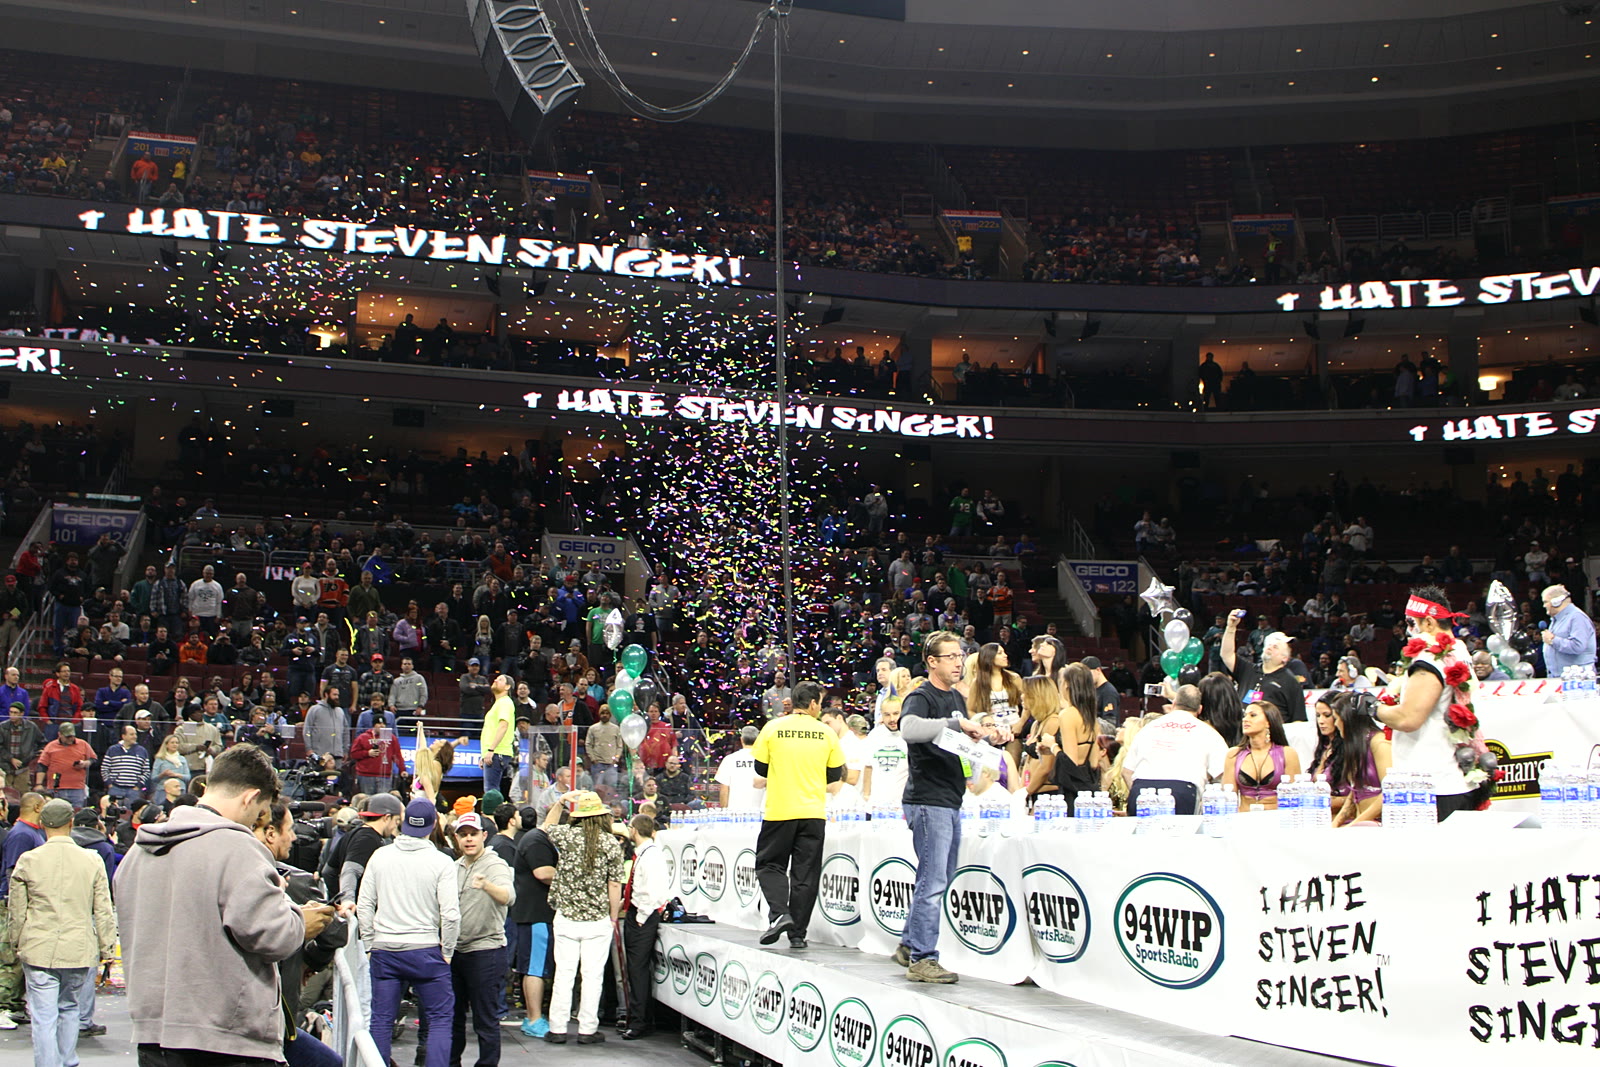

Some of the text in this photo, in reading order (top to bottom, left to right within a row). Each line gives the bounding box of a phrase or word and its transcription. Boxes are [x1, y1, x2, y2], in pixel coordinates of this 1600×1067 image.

[133, 142, 150, 152] 201
[127, 208, 286, 245] HATE
[299, 219, 506, 265] STEVEN
[516, 237, 741, 286] SINGER!
[1319, 279, 1465, 310] HATE
[557, 388, 669, 418] HATE
[677, 395, 824, 429] STEVEN
[831, 407, 994, 440] SINGER!
[1443, 412, 1558, 441] HATE
[54, 528, 77, 543] 101
[63, 512, 127, 529] GEICO
[559, 540, 616, 554] GEICO
[1075, 565, 1130, 577] GEICO
[1111, 580, 1137, 593] 122
[777, 729, 825, 741] REFEREE
[736, 760, 753, 769] EAT
[822, 872, 860, 903] 94WIP
[873, 878, 916, 909] 94WI
[1259, 871, 1367, 915] I HATE
[1024, 891, 1080, 932] 4WIP
[1475, 890, 1492, 927] I
[1125, 902, 1212, 953] 94WIP
[1258, 918, 1377, 964] STEVEN
[1135, 943, 1199, 969] SportsRadio
[1376, 953, 1391, 966] TM
[1255, 966, 1389, 1019] SINGER!
[788, 996, 822, 1031] 94WIP
[834, 1013, 872, 1050] 94WIP
[886, 1032, 934, 1067] 94WIP
